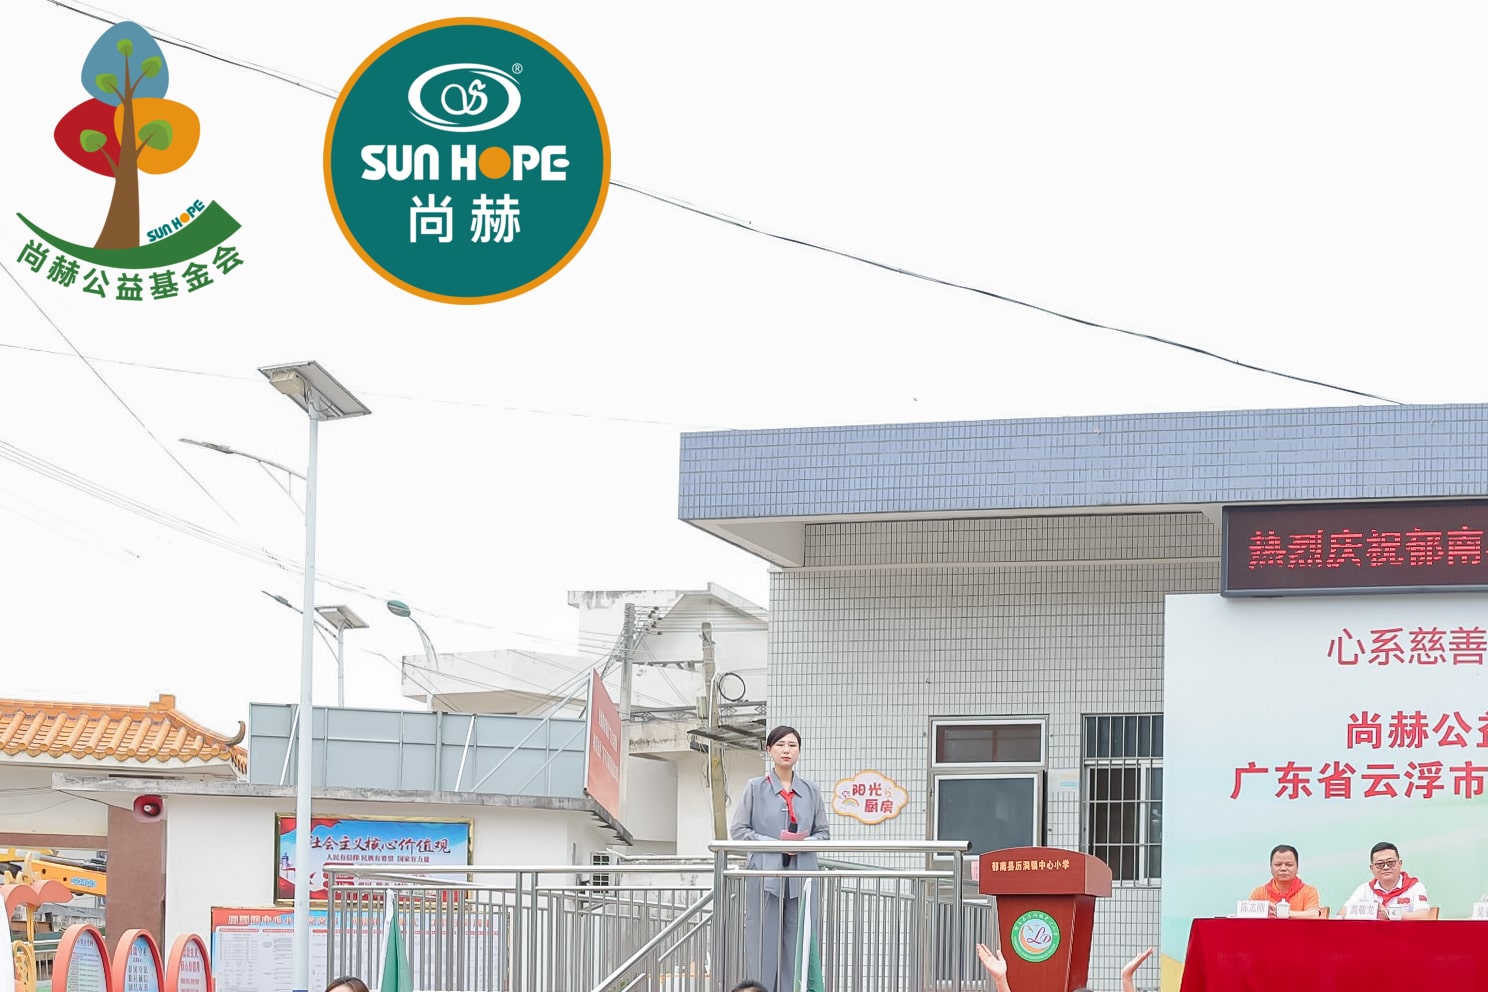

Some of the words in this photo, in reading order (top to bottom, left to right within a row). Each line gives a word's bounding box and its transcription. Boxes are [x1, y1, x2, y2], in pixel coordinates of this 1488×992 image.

[1327, 627, 1487, 665] 心系慈善
[852, 782, 883, 797] 阳光
[864, 798, 894, 814] 厨房
